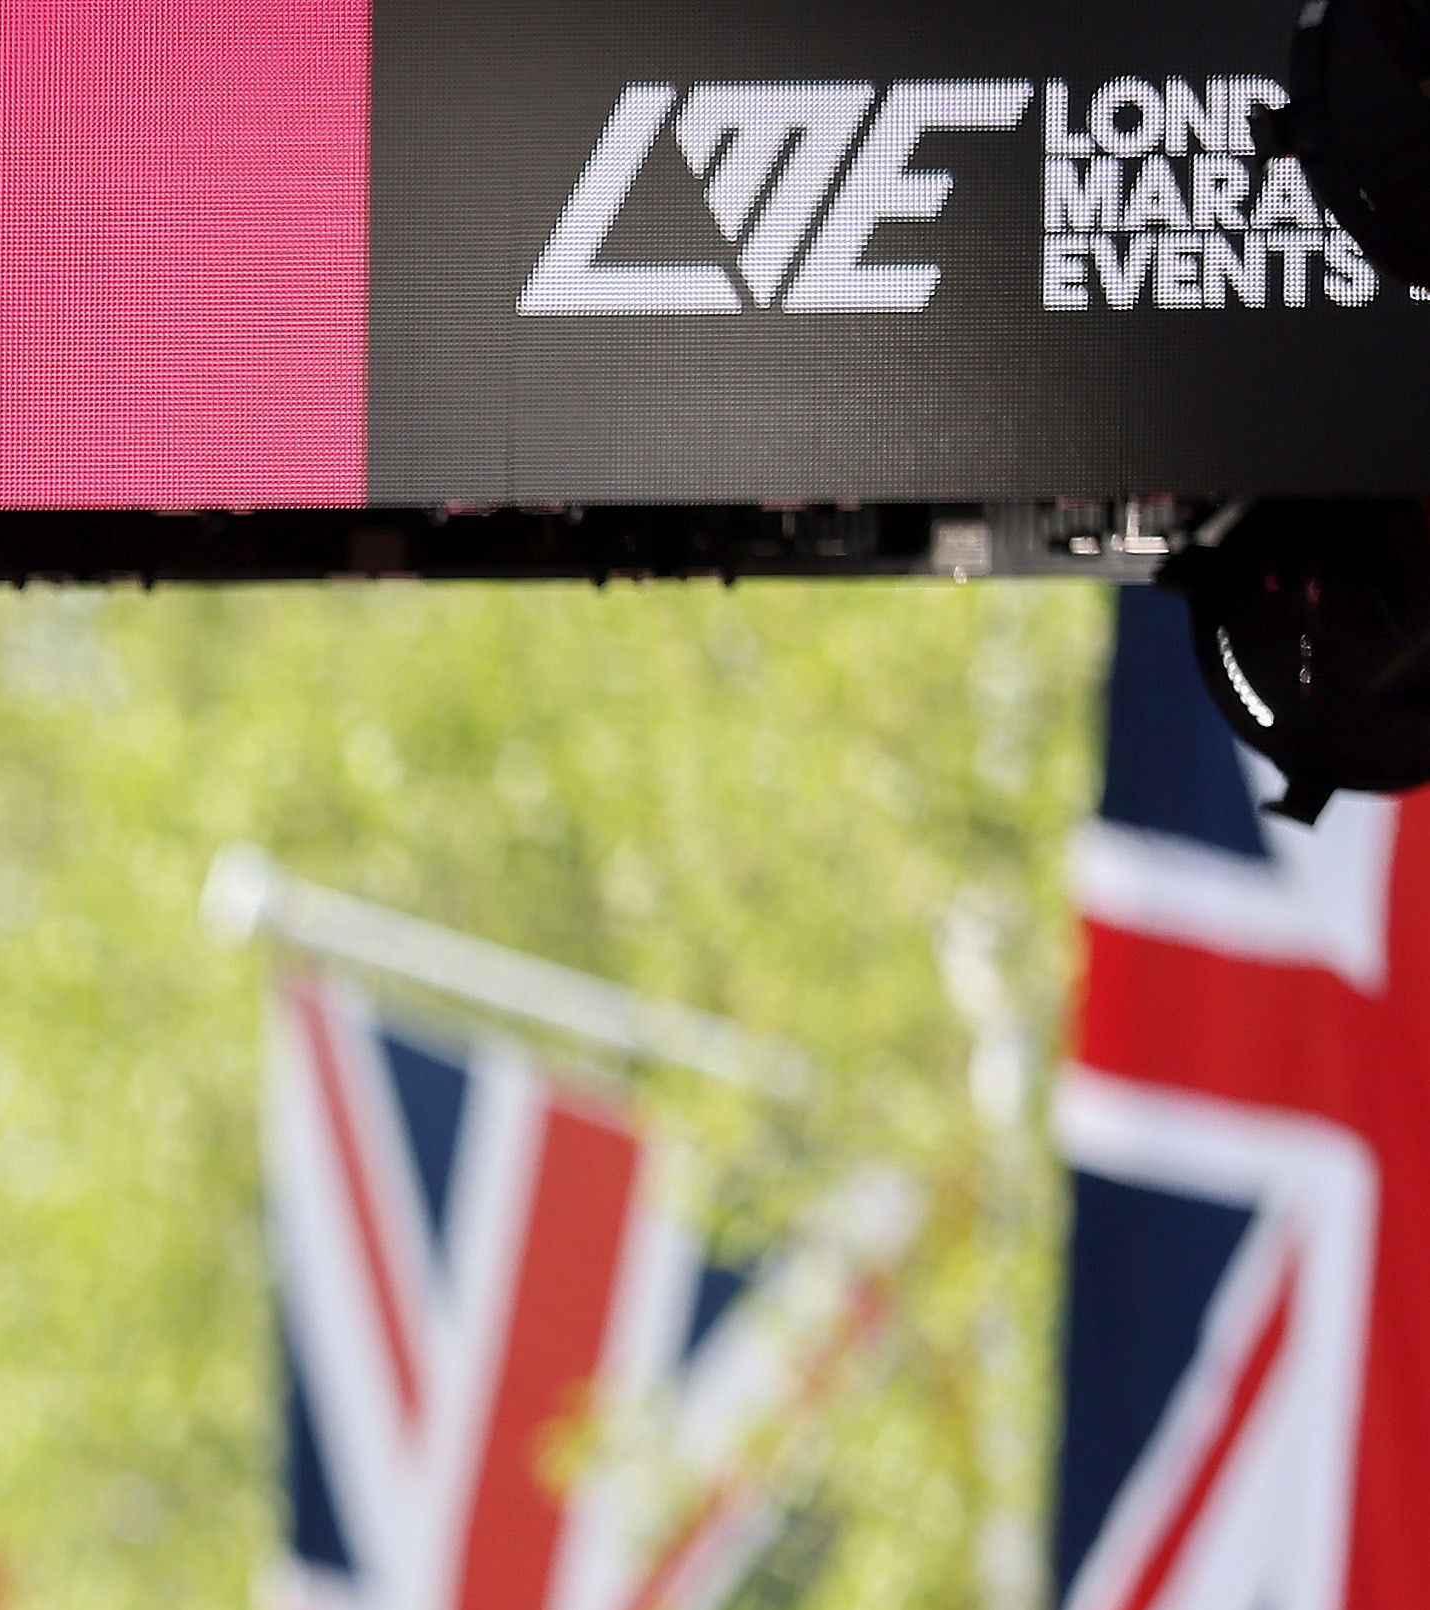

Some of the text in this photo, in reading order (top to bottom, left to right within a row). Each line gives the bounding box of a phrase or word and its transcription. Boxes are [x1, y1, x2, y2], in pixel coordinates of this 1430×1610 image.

[1044, 73, 1291, 157] LOND
[1044, 153, 1339, 231] MARA
[1043, 228, 1379, 310] EVENTS
